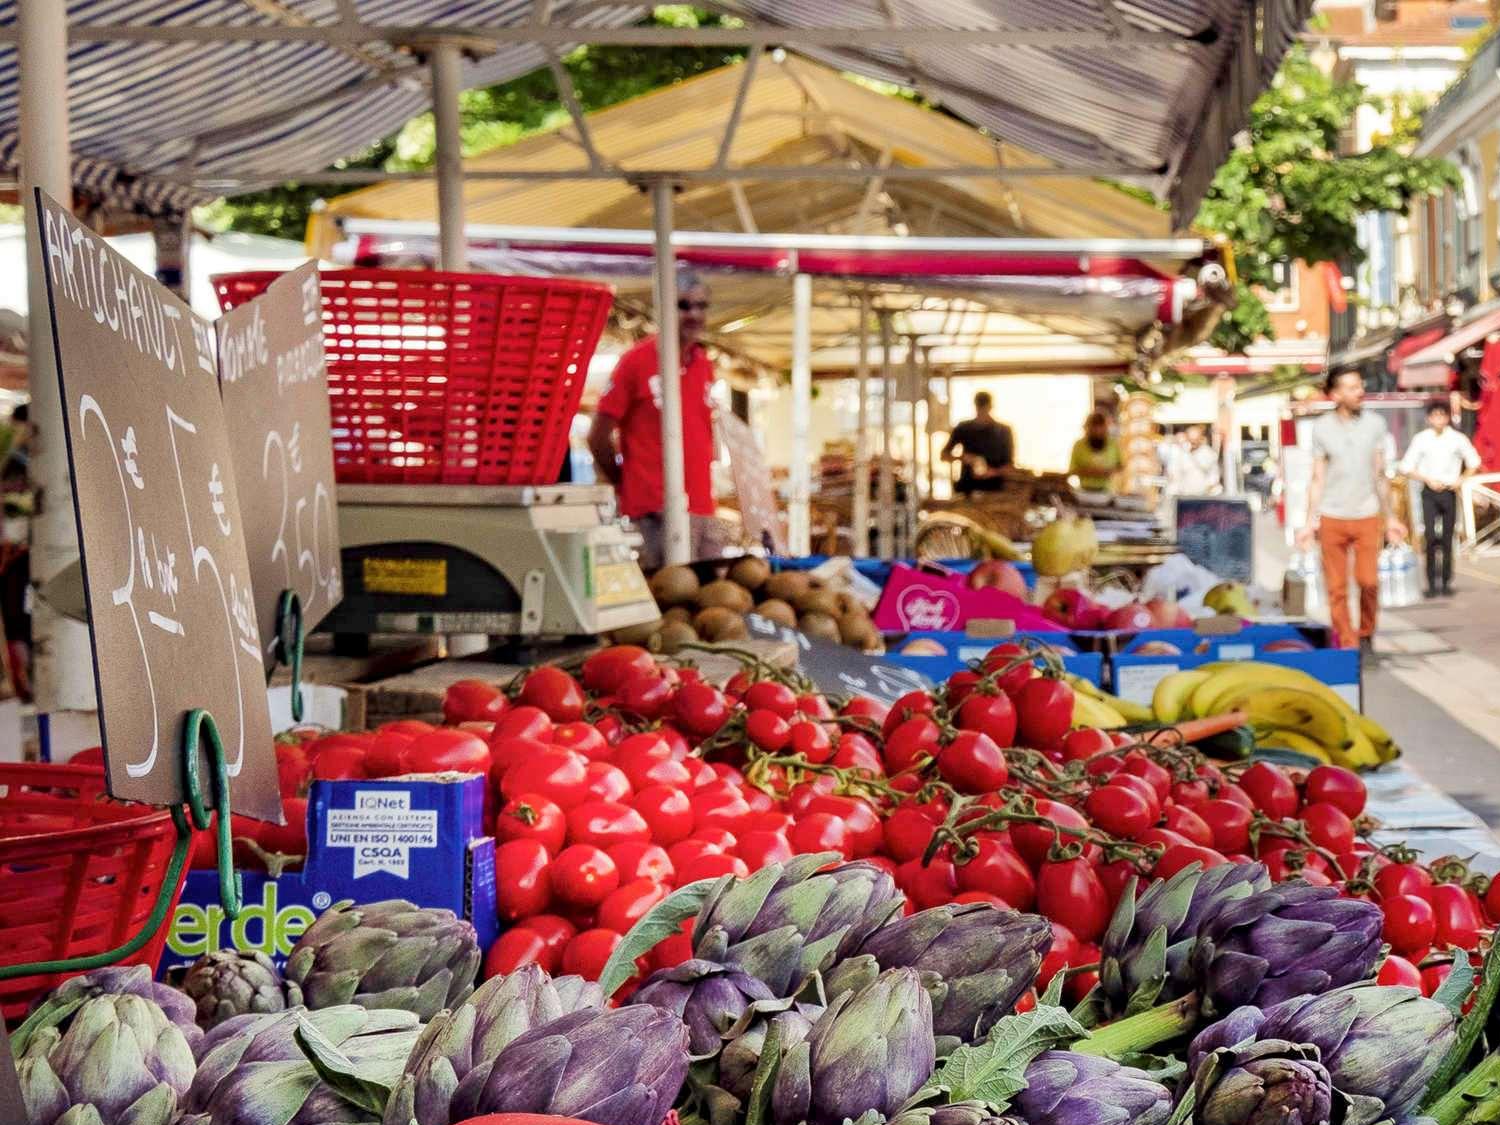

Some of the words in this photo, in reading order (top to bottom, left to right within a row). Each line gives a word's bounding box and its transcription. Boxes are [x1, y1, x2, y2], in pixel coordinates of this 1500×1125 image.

[330, 834, 350, 843] UNI
[353, 834, 368, 843] EN
[371, 834, 389, 843] ISO
[361, 847, 402, 858] CSQA
